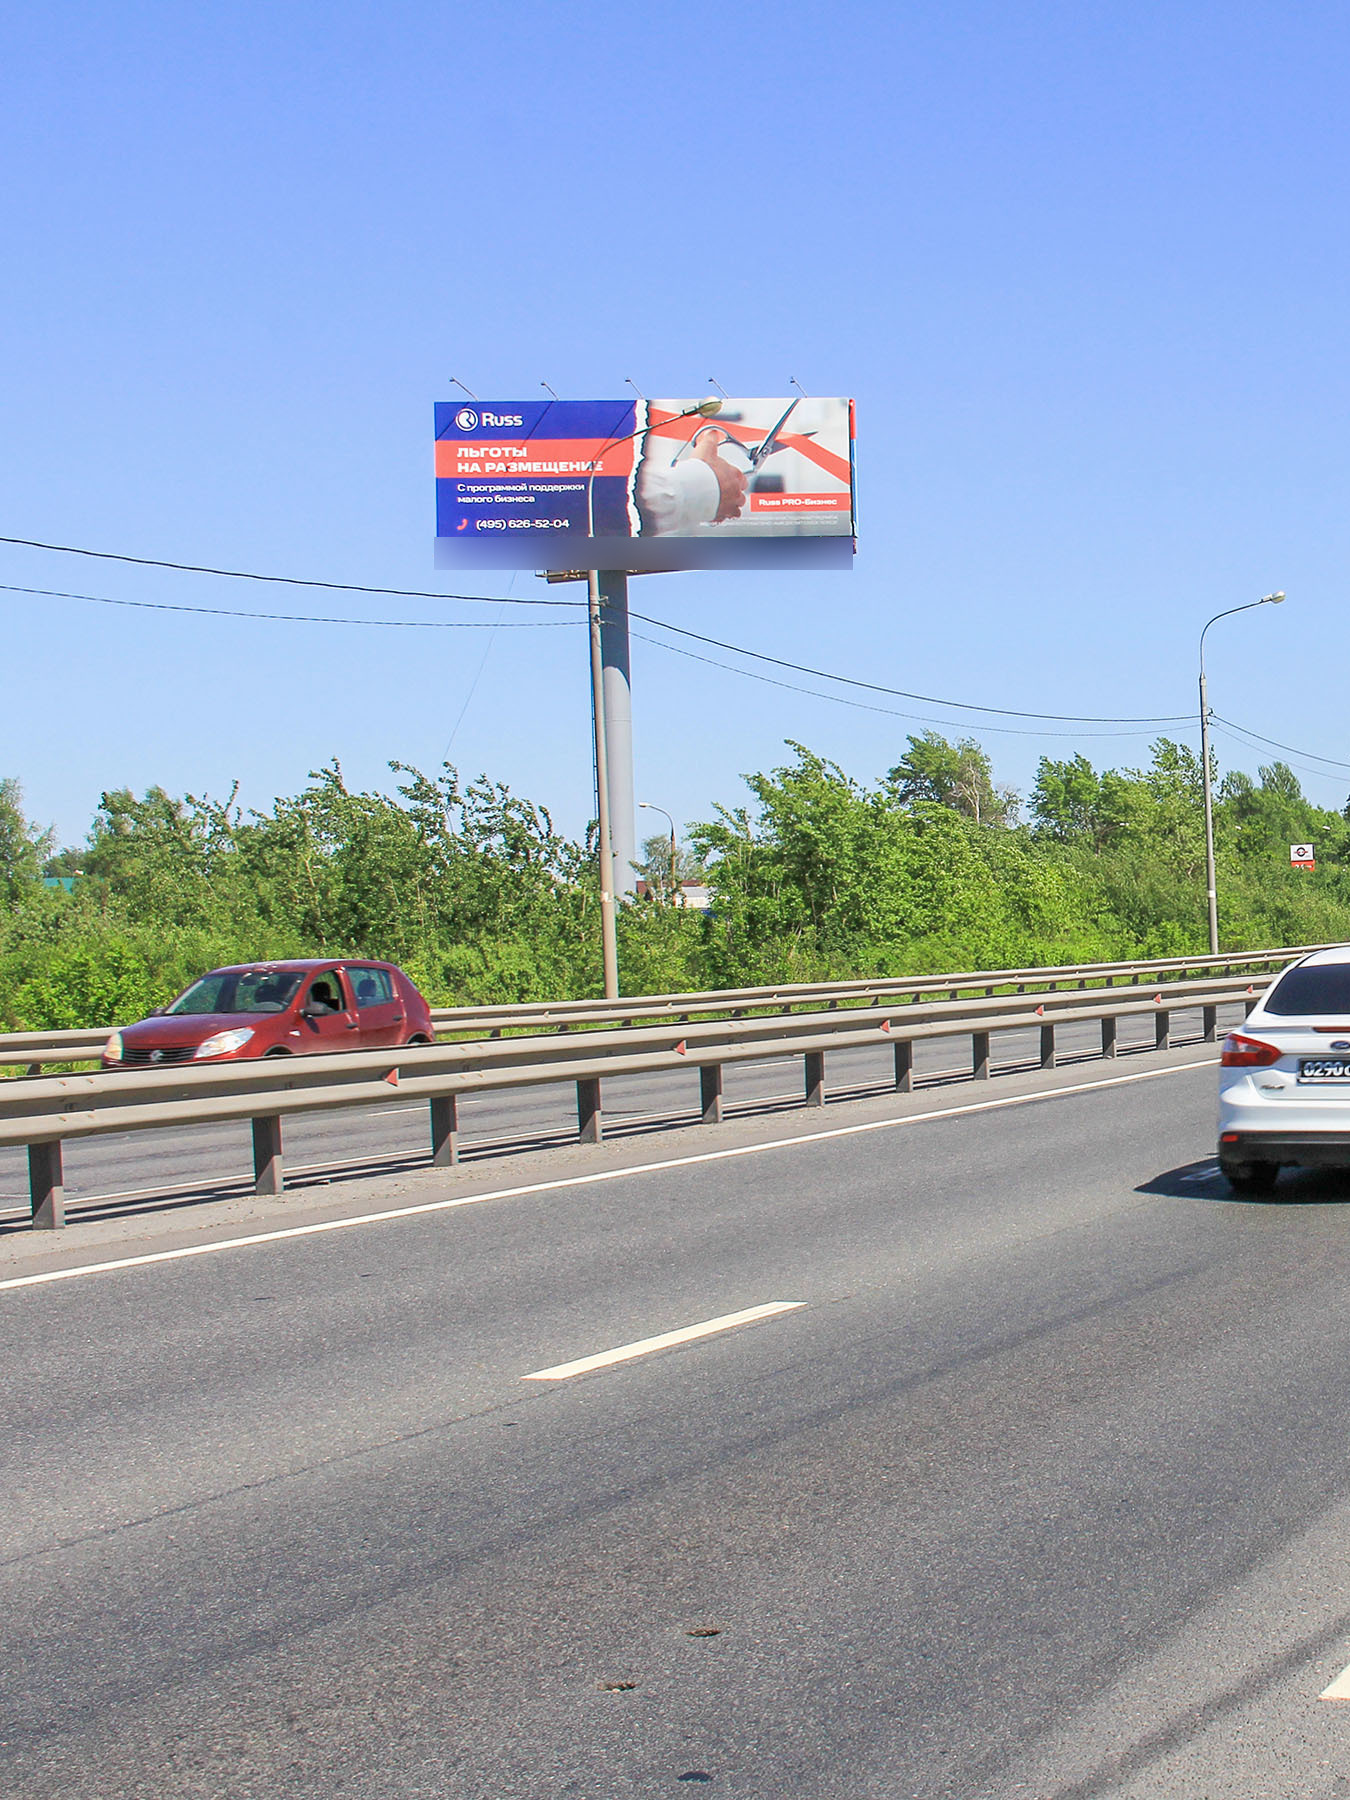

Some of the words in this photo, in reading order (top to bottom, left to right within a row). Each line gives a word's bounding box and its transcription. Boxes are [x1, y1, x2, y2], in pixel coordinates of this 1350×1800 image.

[481, 411, 523, 427] Russ
[457, 447, 527, 458] ЛЬГОТЫ
[457, 462, 481, 473] НА
[485, 461, 603, 474] РАЗМЕЩЕНИЕ
[457, 483, 466, 492] С
[466, 483, 528, 493] программой
[529, 484, 585, 492] поддержки
[494, 494, 535, 503] бизнеса
[476, 519, 506, 531] (495)
[508, 519, 570, 529] 626-52-04
